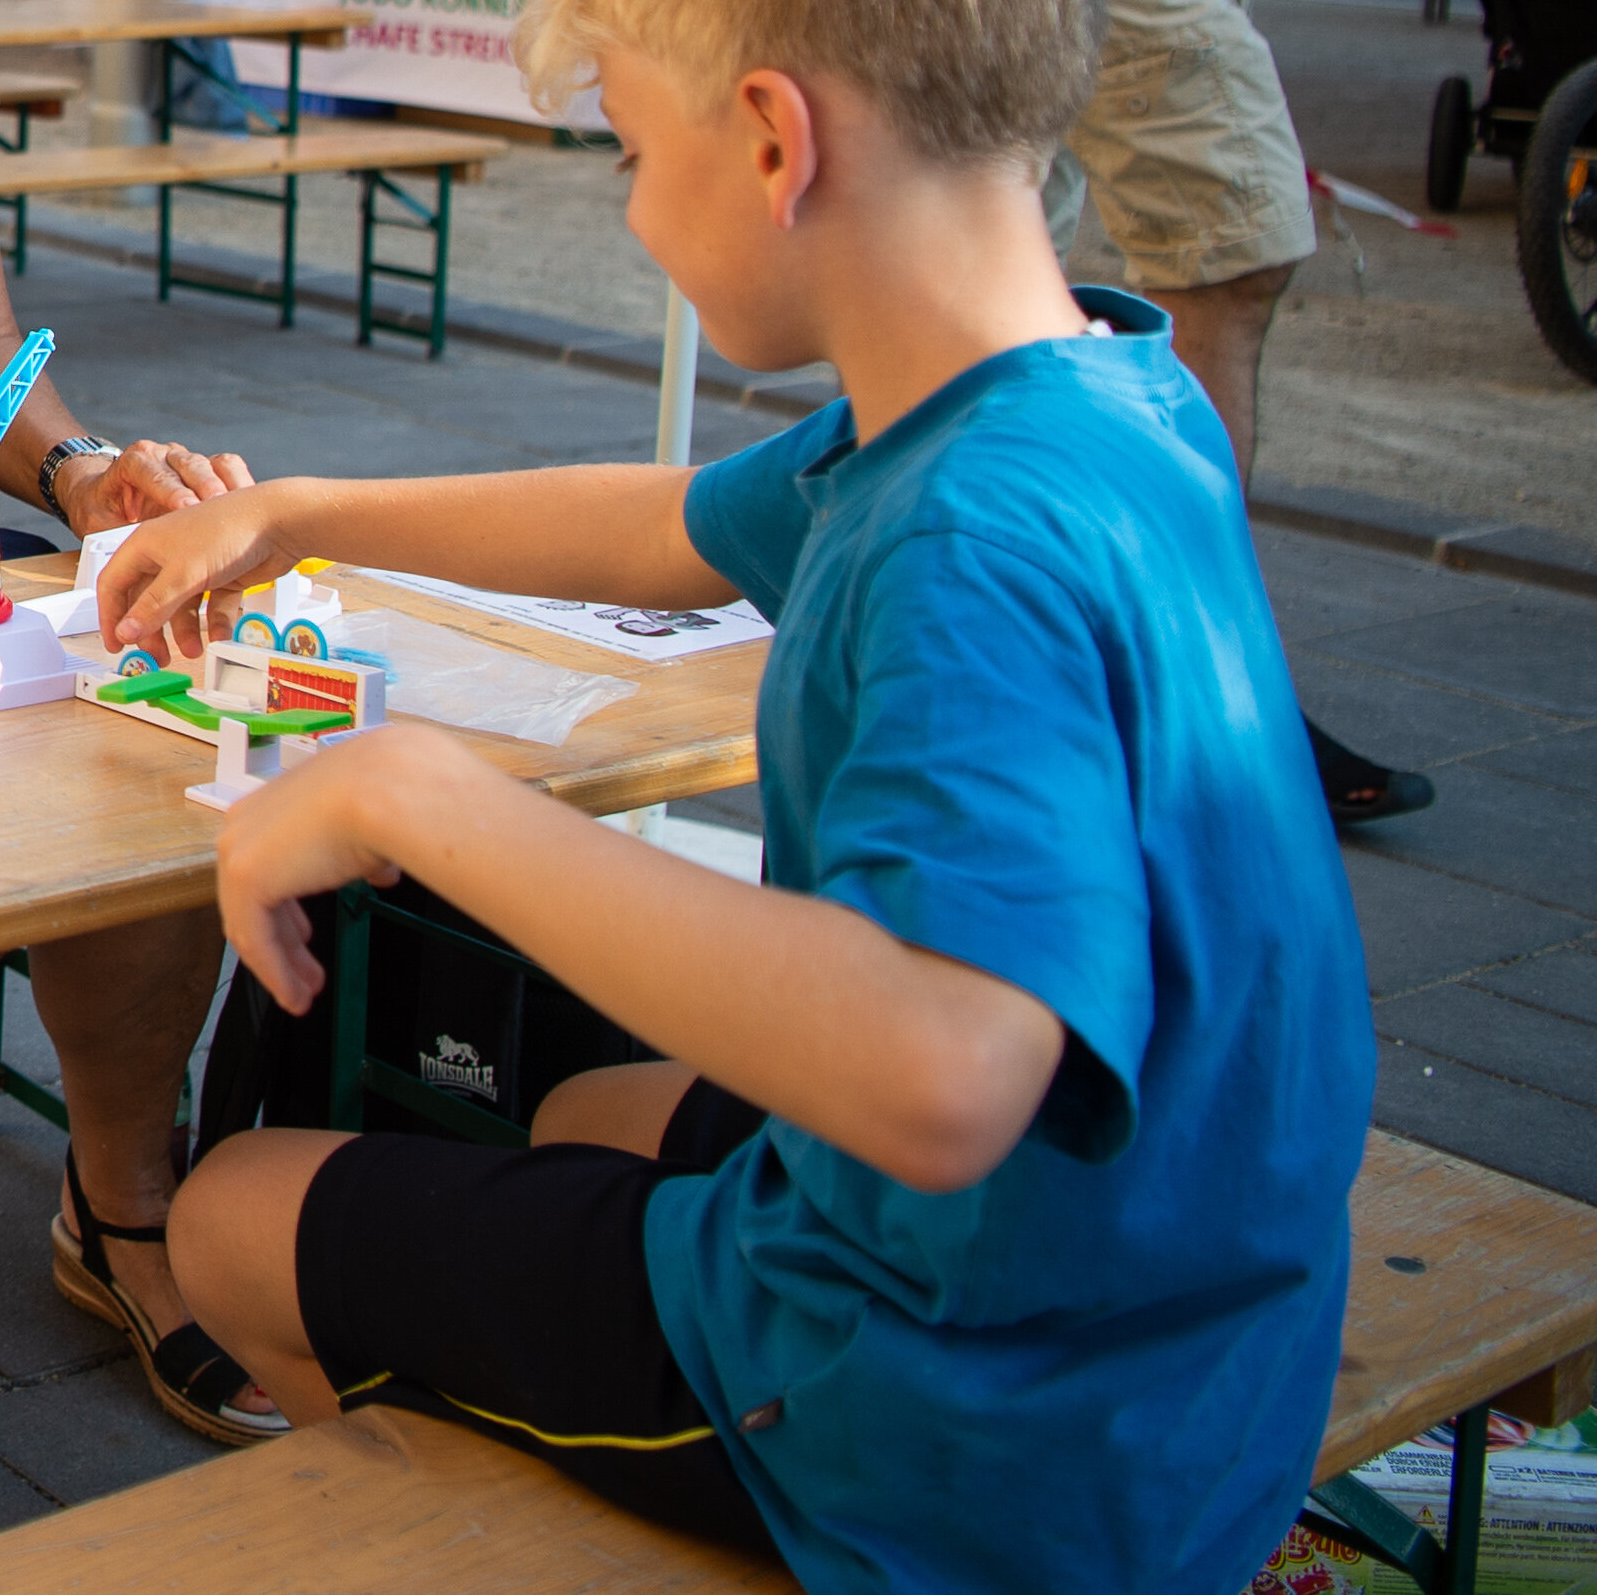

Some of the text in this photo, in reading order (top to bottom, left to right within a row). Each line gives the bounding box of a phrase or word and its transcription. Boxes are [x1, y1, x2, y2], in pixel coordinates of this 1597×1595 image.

[352, 22, 419, 54] HAFE
[418, 1051, 497, 1102] LONSDALE
[1390, 1465, 1451, 1477] ERFORDERLIC
[1489, 1517, 1540, 1531] ATTENTION
[1546, 1521, 1597, 1534] ATTENZION
